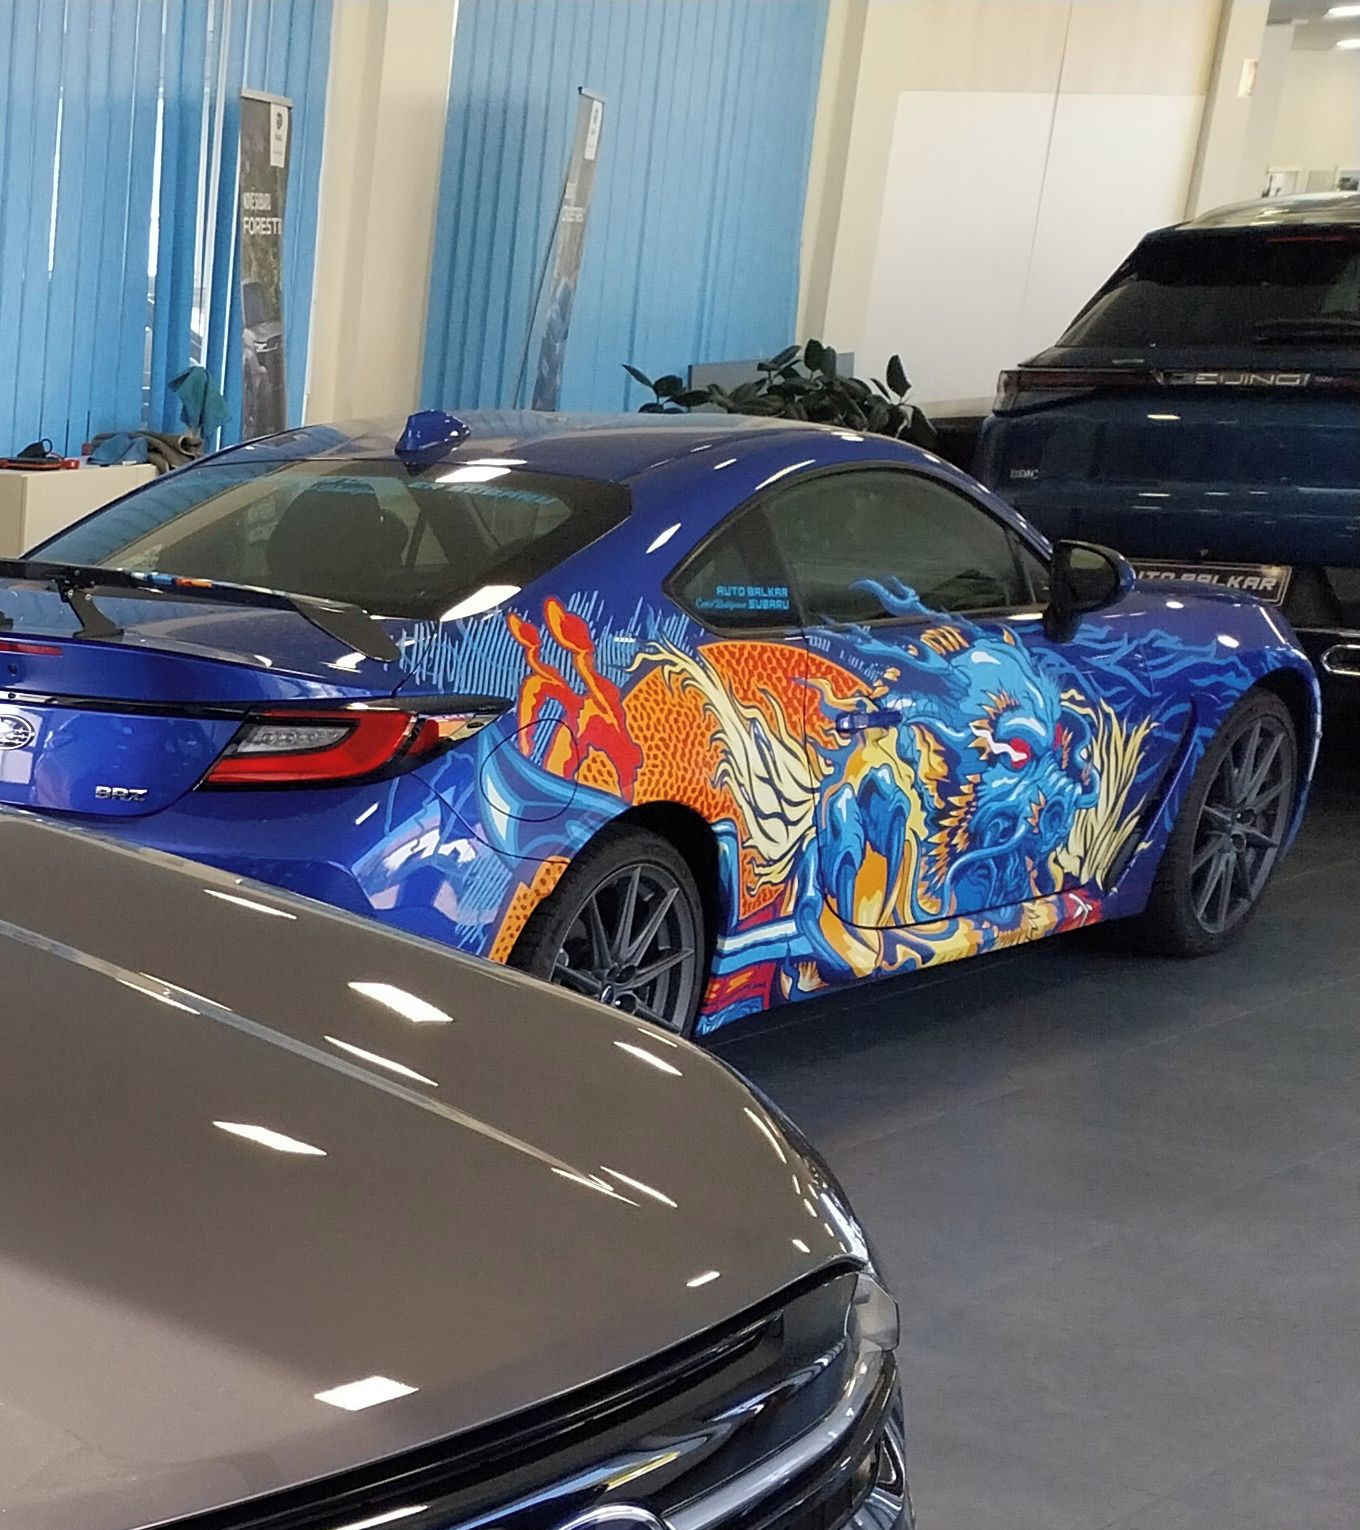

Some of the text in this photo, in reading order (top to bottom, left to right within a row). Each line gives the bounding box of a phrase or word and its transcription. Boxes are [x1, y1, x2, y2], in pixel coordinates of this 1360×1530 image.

[716, 585, 788, 597] AUTO BALKAR
[748, 599, 790, 610] SUBARU
[95, 785, 148, 802] BRZ
